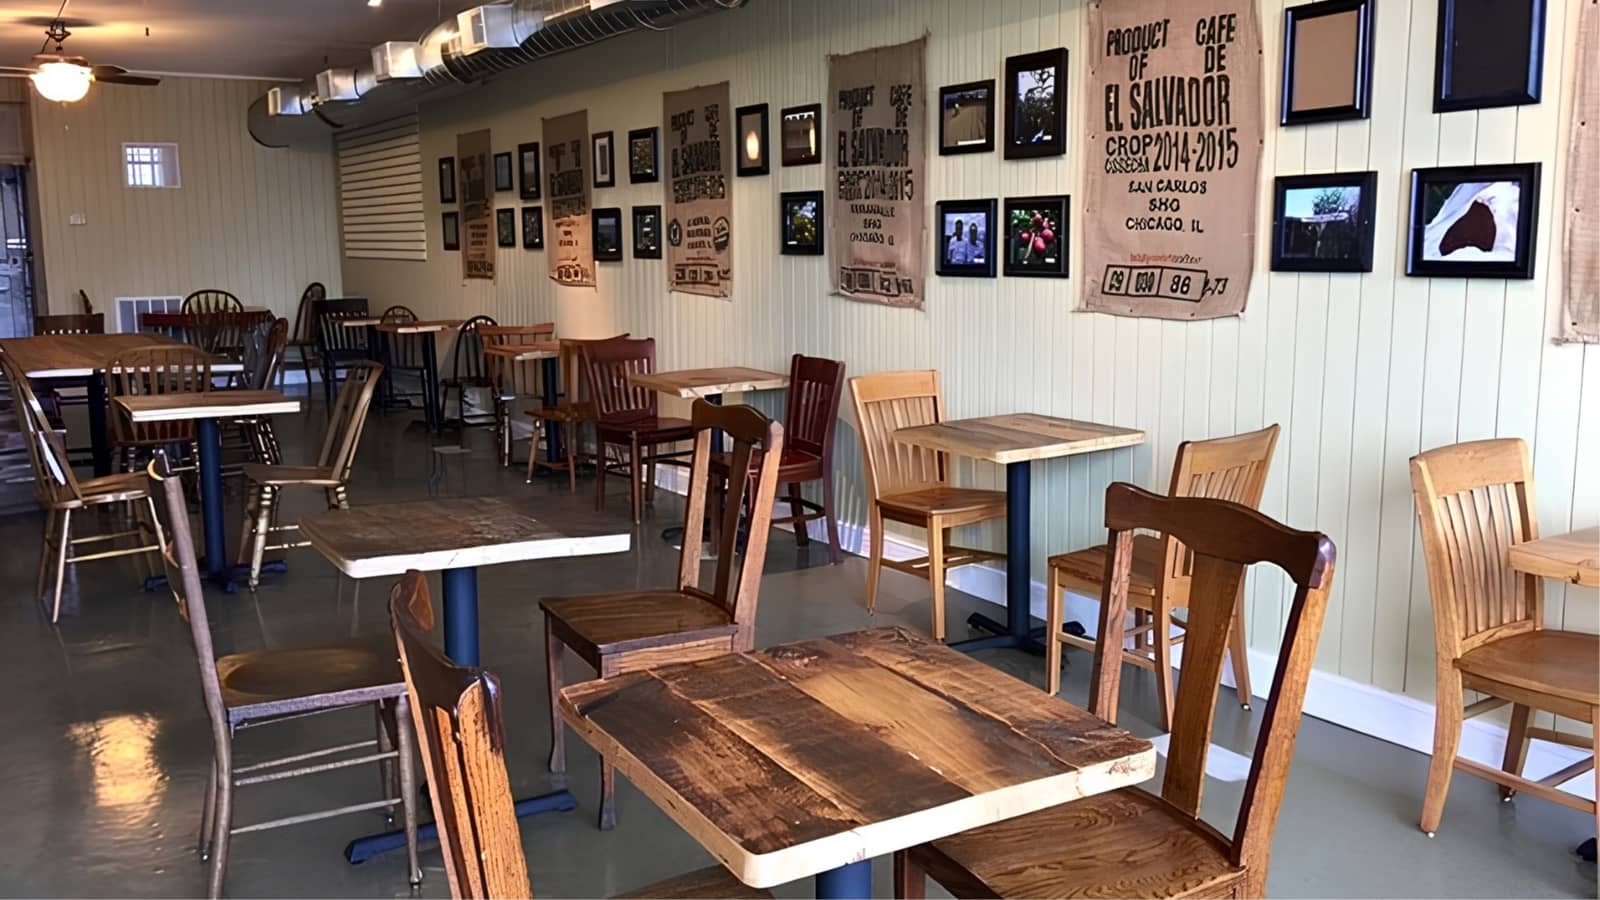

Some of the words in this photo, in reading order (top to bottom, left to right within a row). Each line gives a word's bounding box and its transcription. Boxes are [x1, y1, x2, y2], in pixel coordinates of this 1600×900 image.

[1106, 19, 1170, 57] PRODUCT
[1195, 13, 1237, 46] CAFE
[1129, 54, 1148, 81] OF
[1204, 44, 1226, 74] DE
[1105, 84, 1124, 132] EL
[1129, 74, 1231, 131] SALVADOR
[1105, 134, 1153, 157] CROP
[1156, 179, 1207, 194] CARLOS
[1191, 219, 1204, 233] IL
